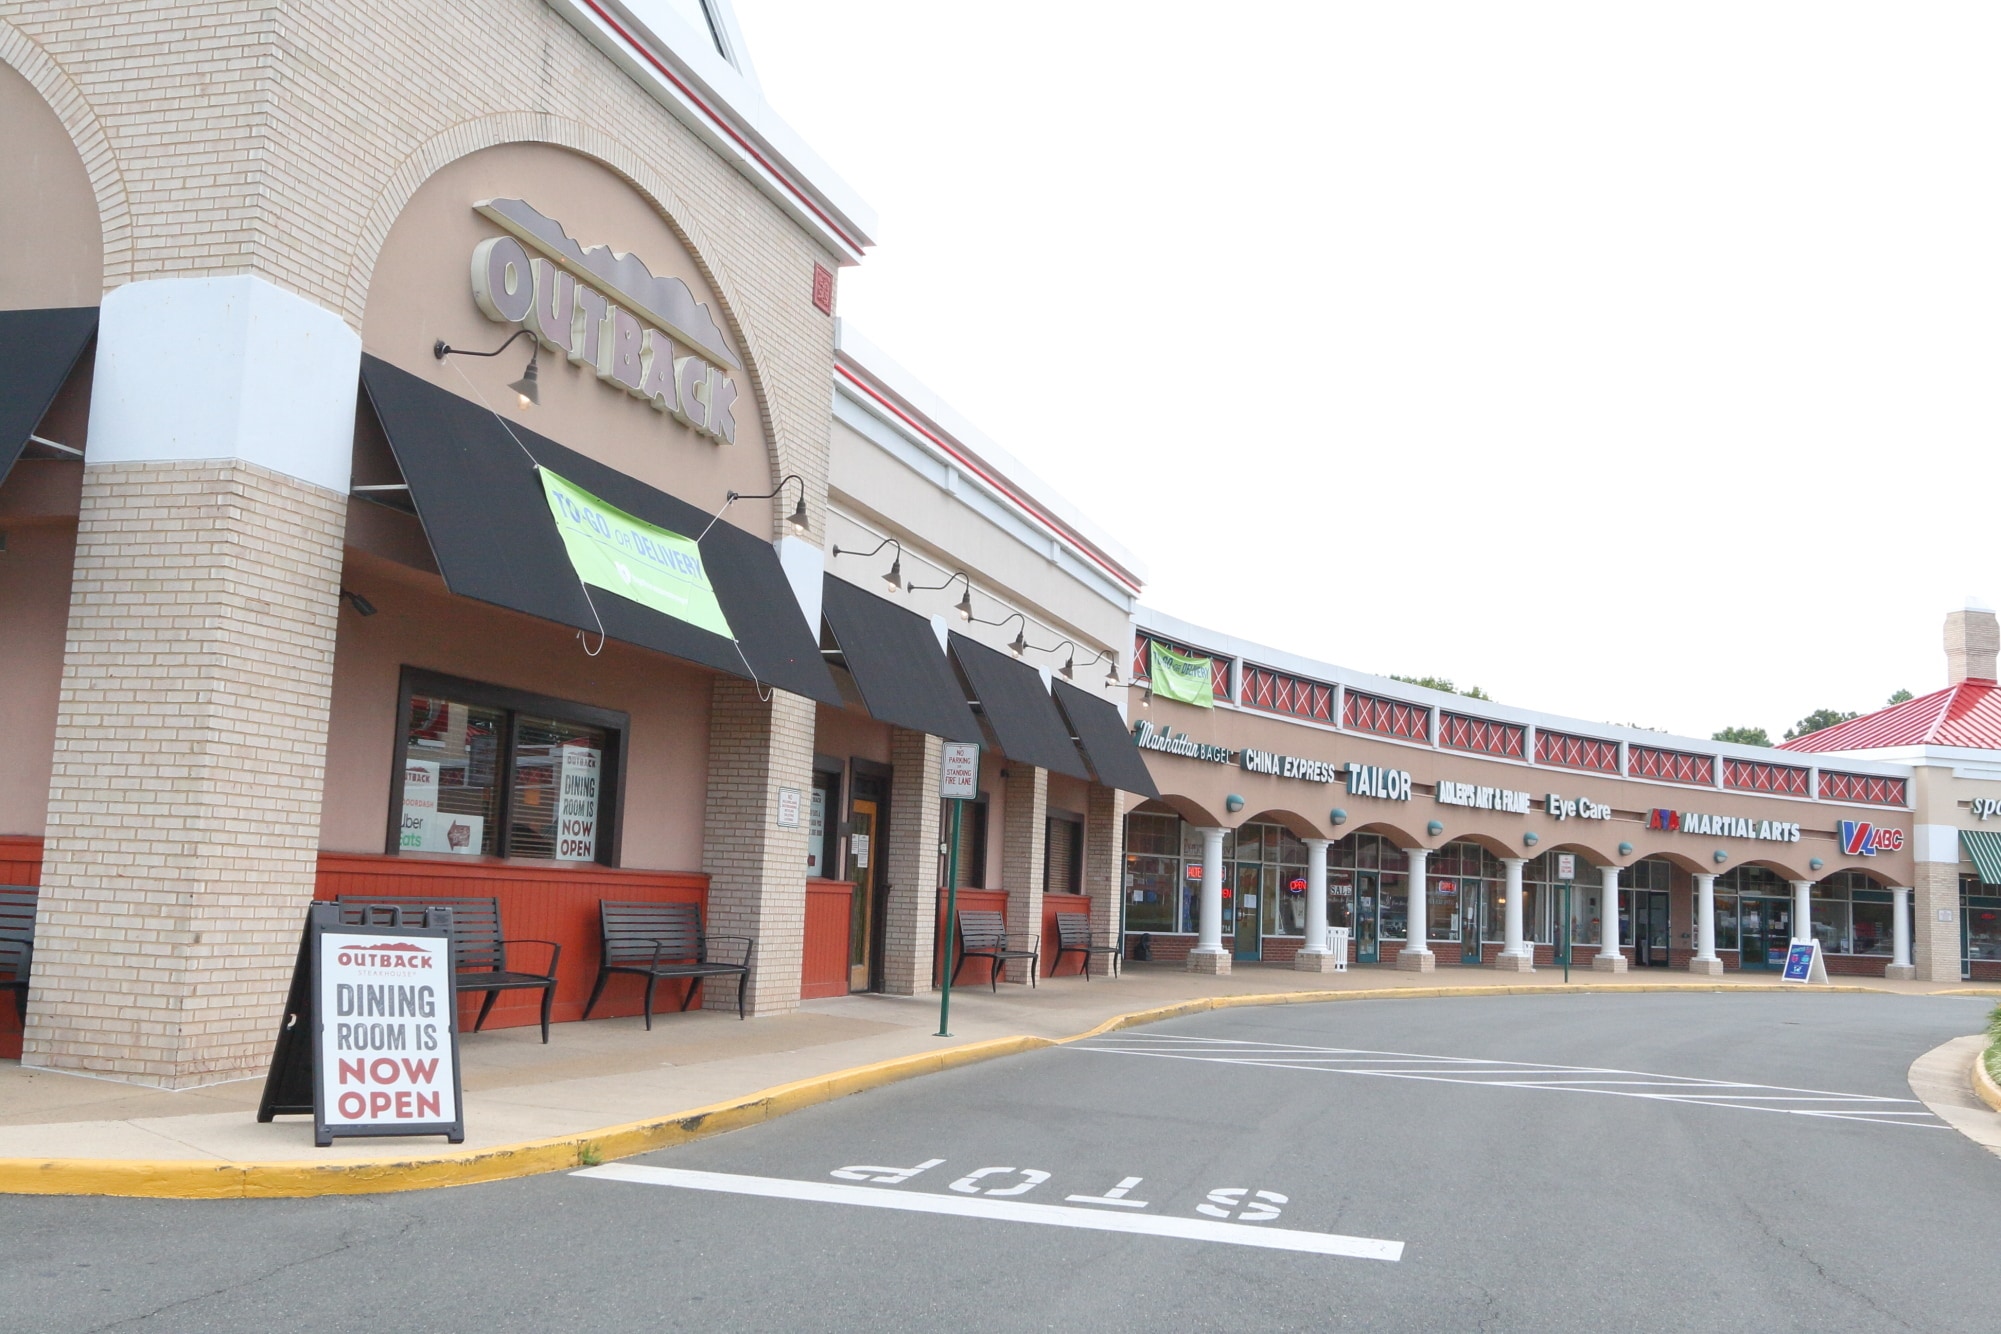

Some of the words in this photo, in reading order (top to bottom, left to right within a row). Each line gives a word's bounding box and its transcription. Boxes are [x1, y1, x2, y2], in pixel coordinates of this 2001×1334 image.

[471, 236, 738, 445] OUTBACK
[552, 490, 611, 539] TO-GO
[630, 530, 703, 580] DELIVERY
[1138, 720, 1200, 758] Manhattan
[1200, 744, 1231, 764] BAGEL
[567, 755, 596, 769] OUTBACK
[946, 769, 972, 777] STANDING
[948, 757, 971, 765] PARKING
[1245, 748, 1280, 776] CHINA
[1284, 756, 1335, 784] EXPRESS
[564, 774, 595, 798] DINING
[958, 777, 972, 786] LANE
[1348, 762, 1412, 801] TAILOR
[563, 798, 585, 817] ROOM
[586, 801, 594, 818] IS
[1475, 786, 1494, 810] ART
[1494, 788, 1502, 811] &
[1502, 789, 1531, 814] FRAME
[1550, 794, 1577, 821] Eye
[1578, 797, 1612, 820] Care
[562, 819, 593, 838] NOW
[1683, 812, 1757, 838] MARTIAL
[1759, 820, 1801, 843] ARTS
[560, 839, 592, 857] OPEN
[1290, 881, 1307, 890] OPEN
[1331, 885, 1352, 895] SALE
[337, 952, 433, 969] OUTBACK
[336, 983, 435, 1018] DINING
[337, 1022, 406, 1051] ROOM
[415, 1023, 438, 1051] IS
[338, 1057, 440, 1085] NOW
[337, 1091, 441, 1119] OPEN
[829, 1158, 1290, 1221] STOP
